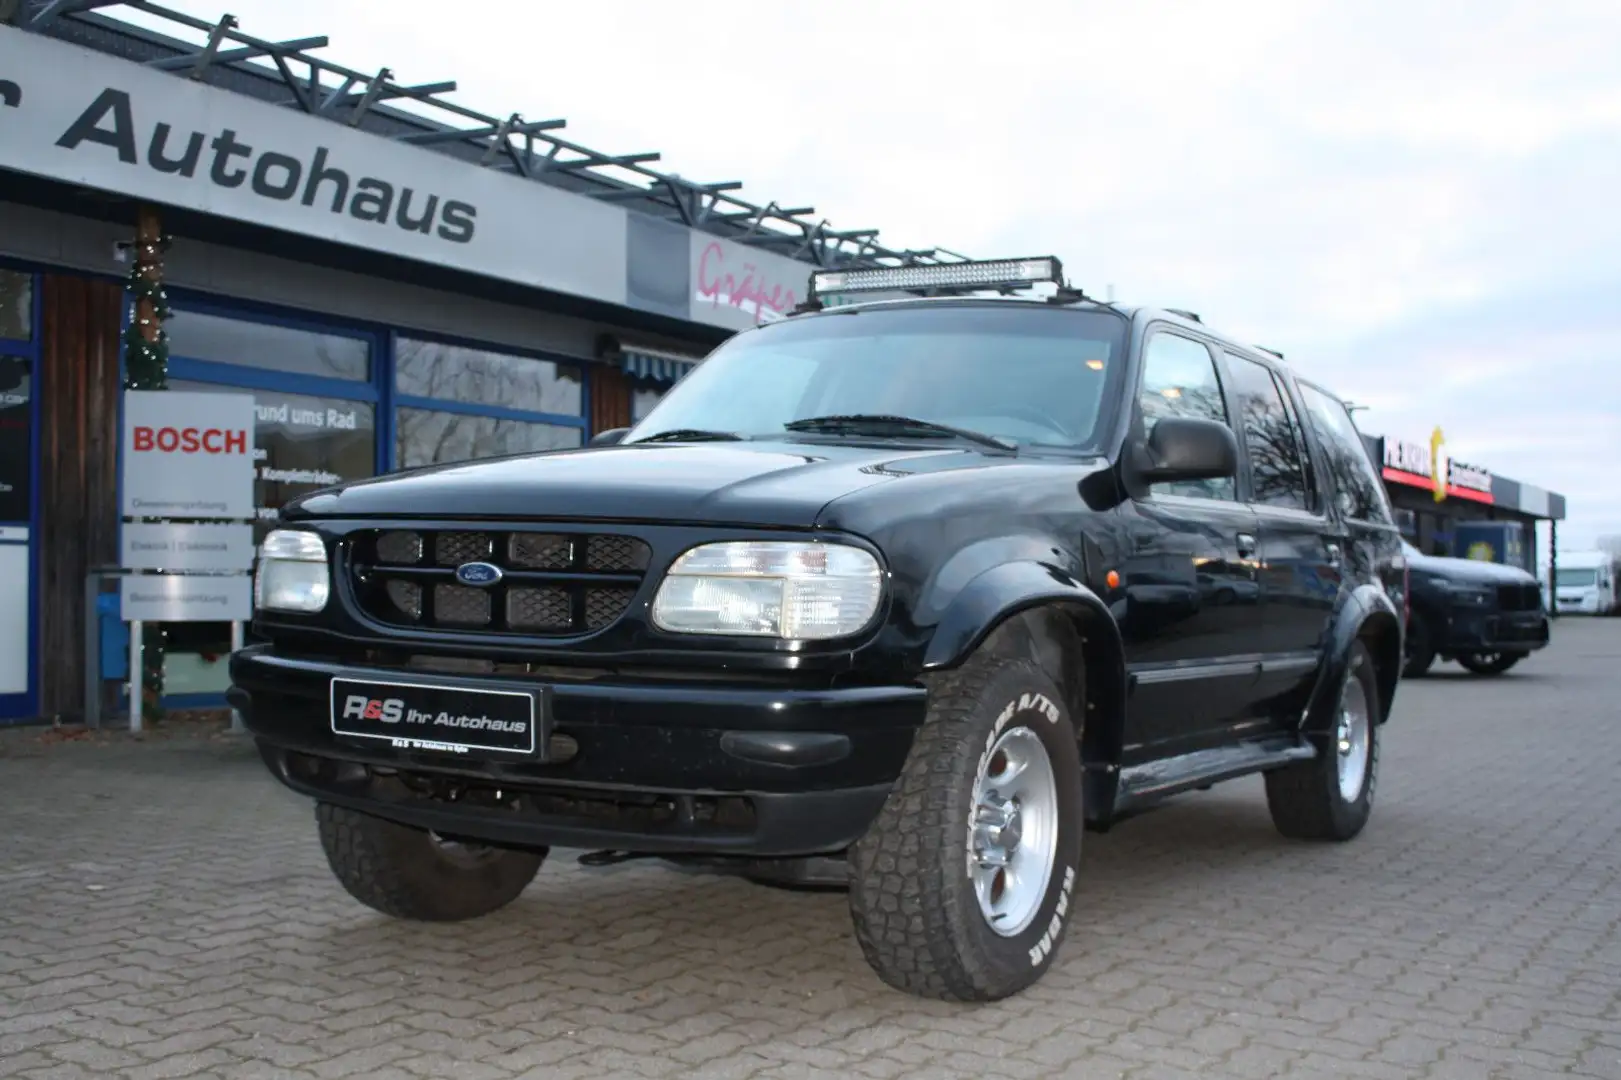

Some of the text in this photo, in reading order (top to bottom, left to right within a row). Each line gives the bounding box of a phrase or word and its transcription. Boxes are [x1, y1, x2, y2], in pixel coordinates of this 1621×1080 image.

[55, 87, 477, 243] Autohaus
[292, 408, 325, 428] ums
[327, 407, 357, 429] Rad
[133, 426, 247, 454] BOSCH
[343, 695, 527, 733] R&S Ihr Autohaus
